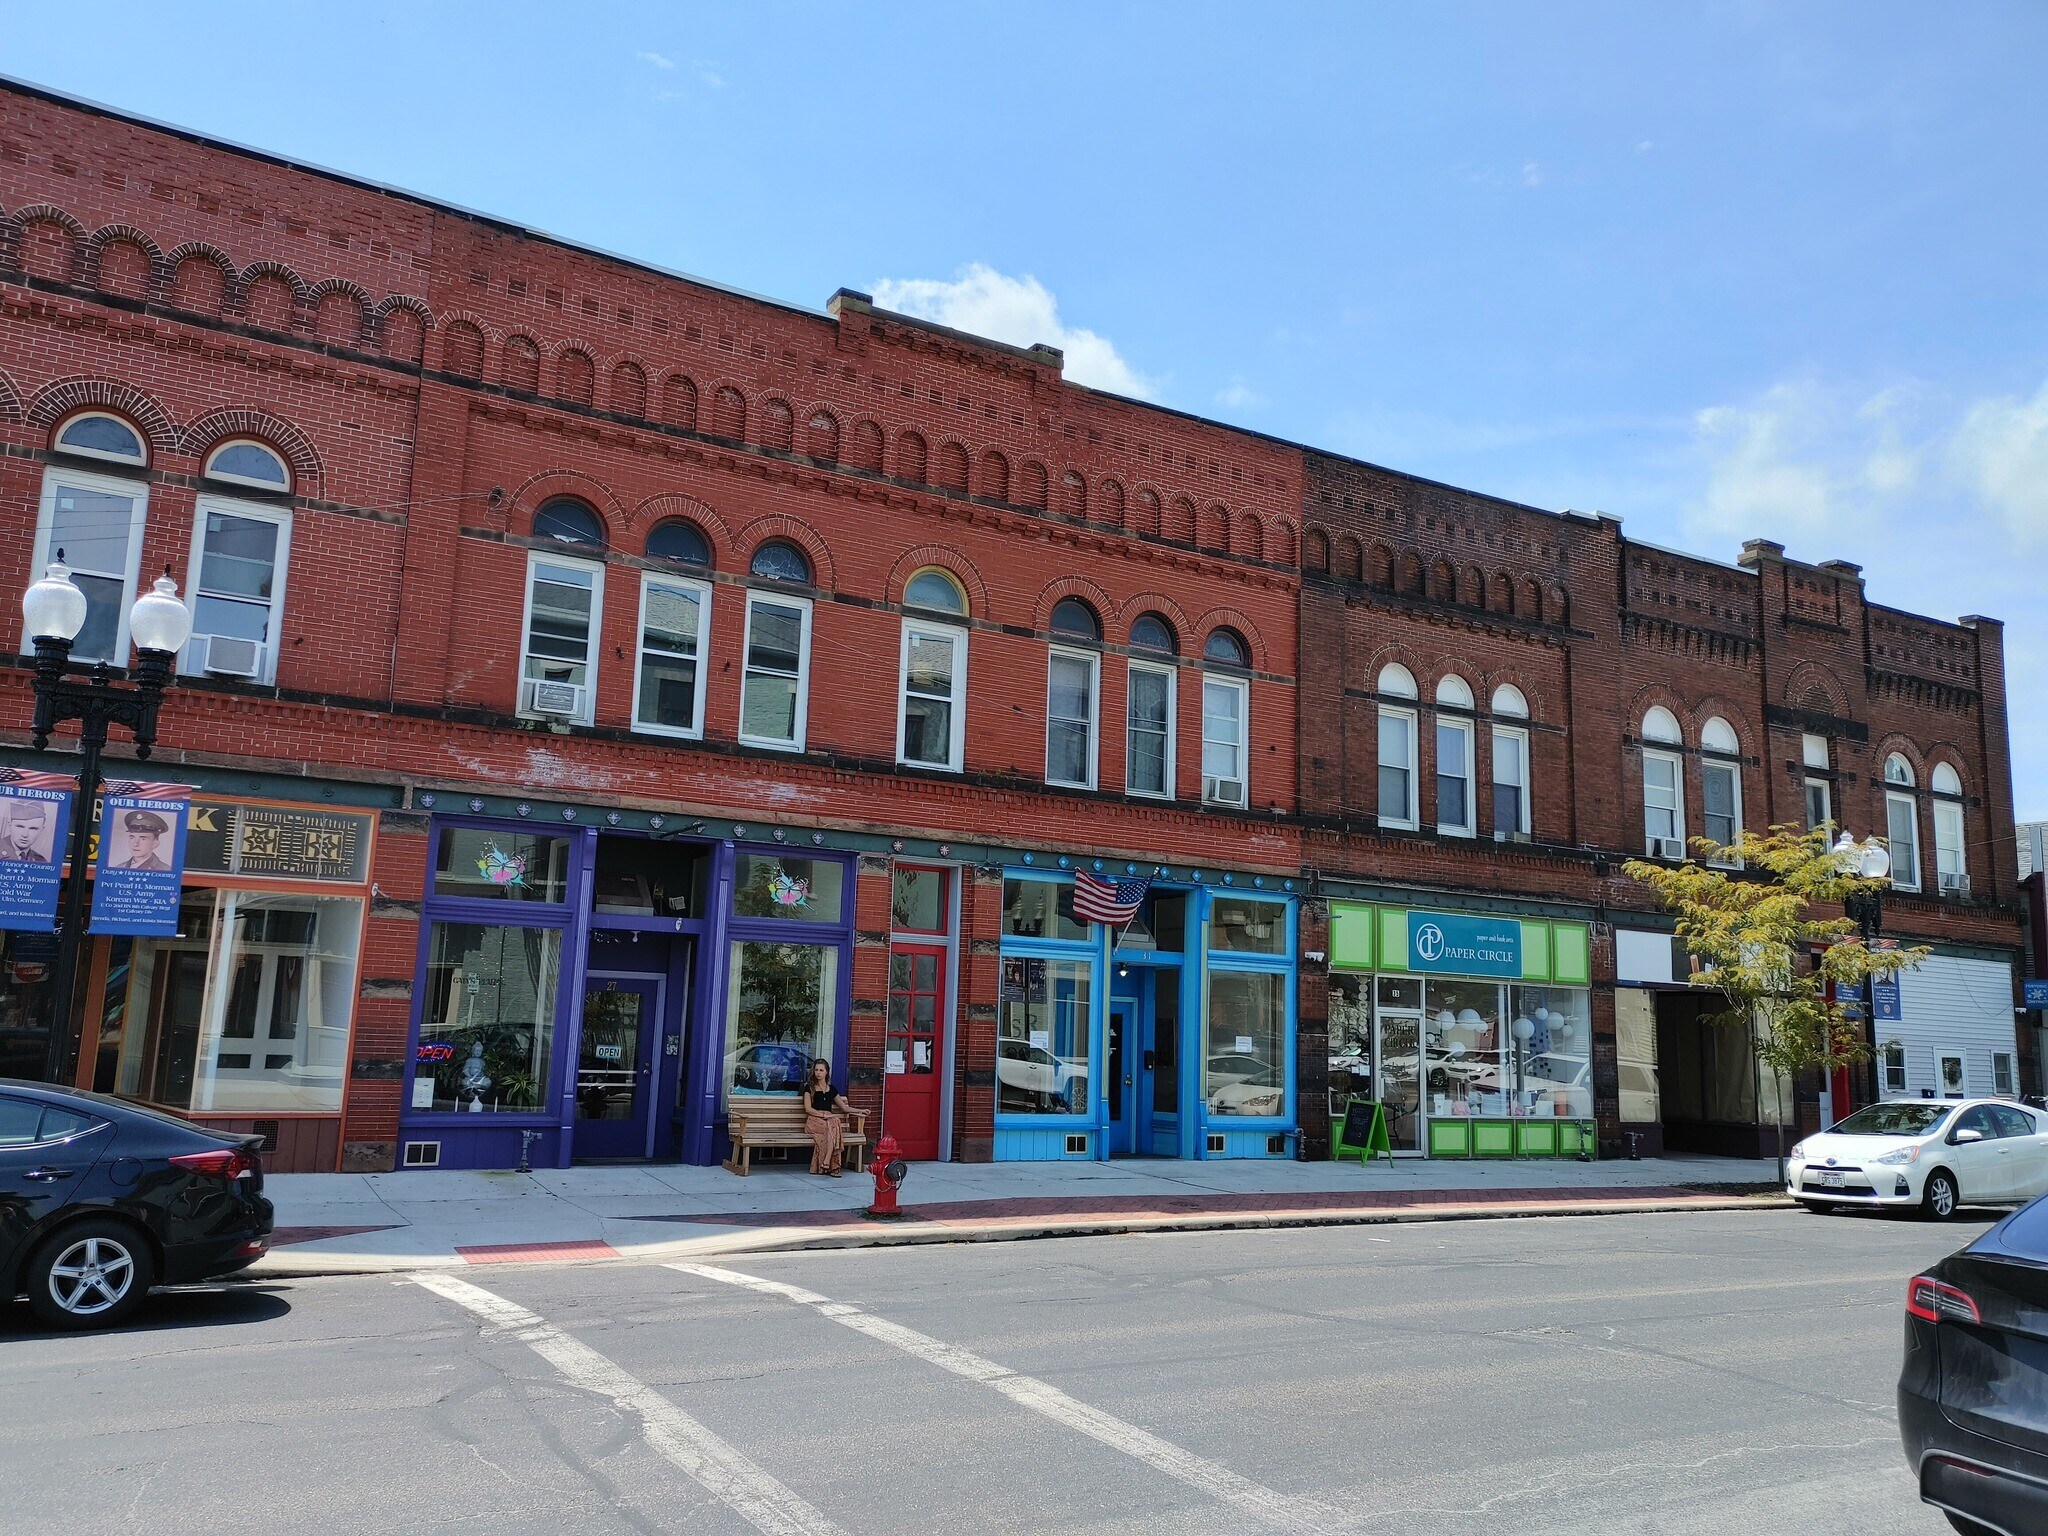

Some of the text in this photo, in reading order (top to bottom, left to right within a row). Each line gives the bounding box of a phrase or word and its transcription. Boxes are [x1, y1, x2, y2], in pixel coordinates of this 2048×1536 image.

[17, 787, 66, 801] HEROES
[109, 797, 184, 811] OUR HEROES
[30, 863, 56, 871] Country
[102, 868, 118, 876] Duty
[151, 871, 176, 879] Country
[28, 876, 58, 885] Morman
[13, 882, 34, 891] Army
[145, 884, 175, 892] Morman
[17, 890, 32, 898] War
[119, 889, 155, 899] U.S. Army
[18, 897, 46, 905] Germany
[106, 896, 132, 904] Korean
[134, 897, 149, 905] War
[1477, 934, 1488, 942] paper
[1143, 951, 1151, 961] 31
[1445, 946, 1513, 963] PAPER CIRCLE
[606, 980, 617, 991] 27
[1385, 1025, 1416, 1035] PAPER
[598, 1046, 621, 1058] OPEN
